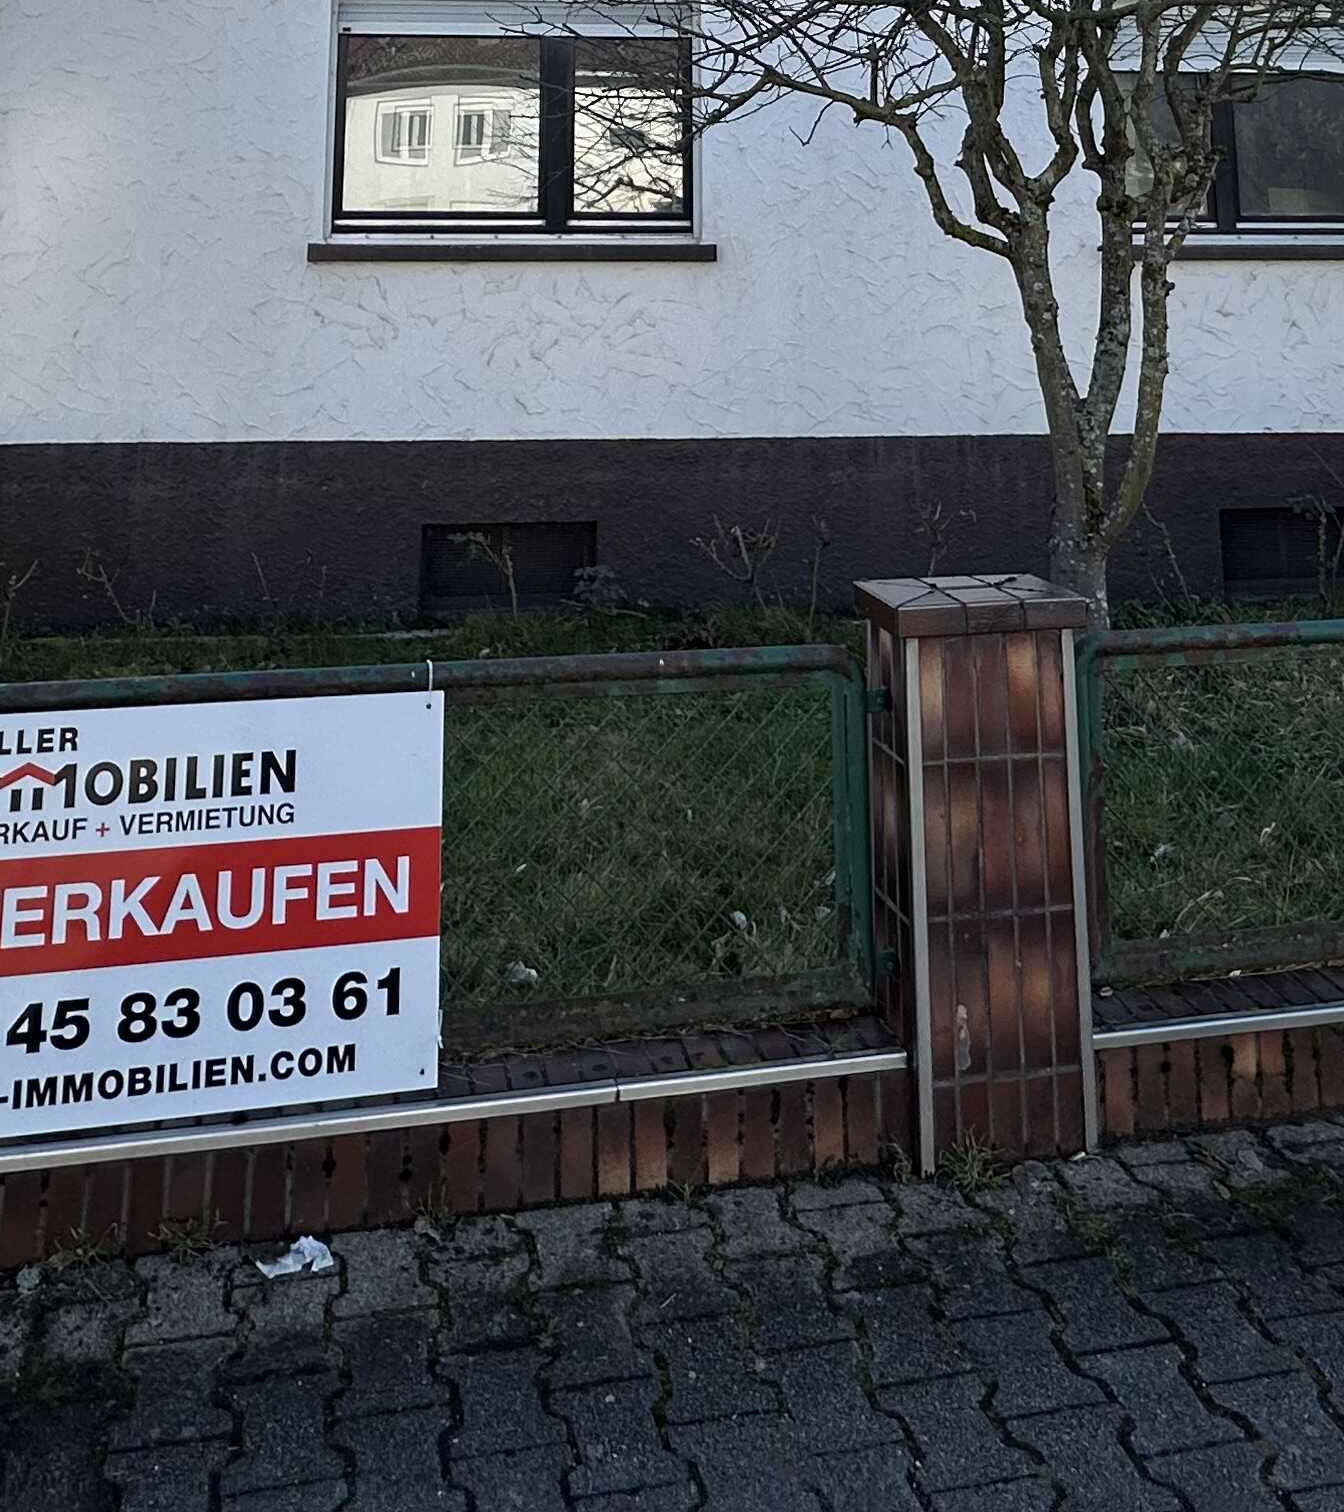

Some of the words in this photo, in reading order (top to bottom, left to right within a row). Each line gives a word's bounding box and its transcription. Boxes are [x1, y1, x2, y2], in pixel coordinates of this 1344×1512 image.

[95, 822, 111, 838] +
[119, 802, 295, 836] VERMIETUNG
[5, 997, 91, 1055] 45
[117, 987, 201, 1044] 83
[226, 977, 307, 1032] 03
[332, 966, 401, 1021] 61
